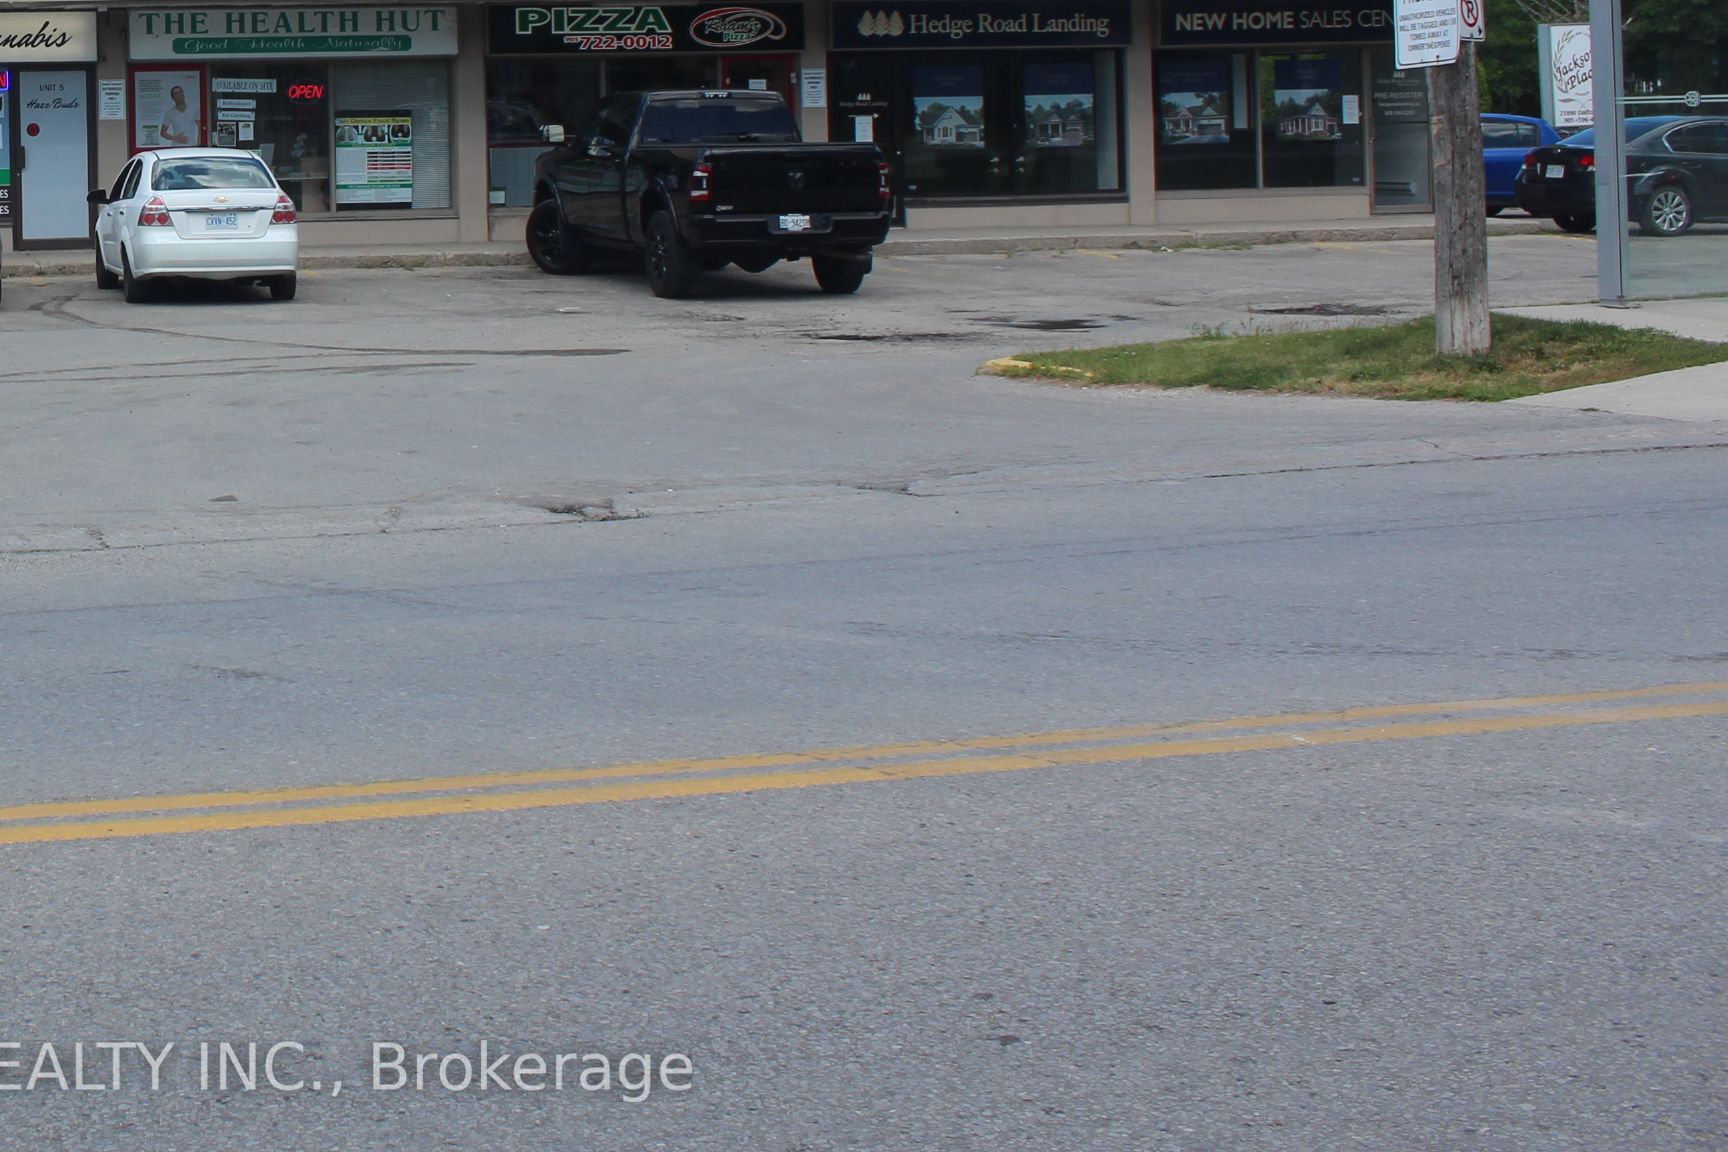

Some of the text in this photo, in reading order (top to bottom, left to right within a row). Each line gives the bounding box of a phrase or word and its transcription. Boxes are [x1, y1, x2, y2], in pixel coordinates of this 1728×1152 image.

[138, 9, 445, 35] THE HEALTH HUT
[515, 7, 673, 34] PIZZA
[909, 12, 1110, 38] Hedge Road Landing
[1175, 12, 1227, 31] NEW
[1232, 11, 1295, 30] HOME
[1299, 10, 1352, 29] SALES
[184, 38, 228, 51] Good
[313, 37, 403, 51] Naturally
[578, 35, 673, 50] 722-0012
[723, 33, 752, 42] Pizza
[1556, 50, 1592, 81] Jackso
[59, 83, 64, 91] 5
[216, 81, 247, 90] AVAILABLE
[248, 81, 260, 90] ON
[288, 84, 324, 99] OPEN
[26, 97, 79, 109] Haze Buds
